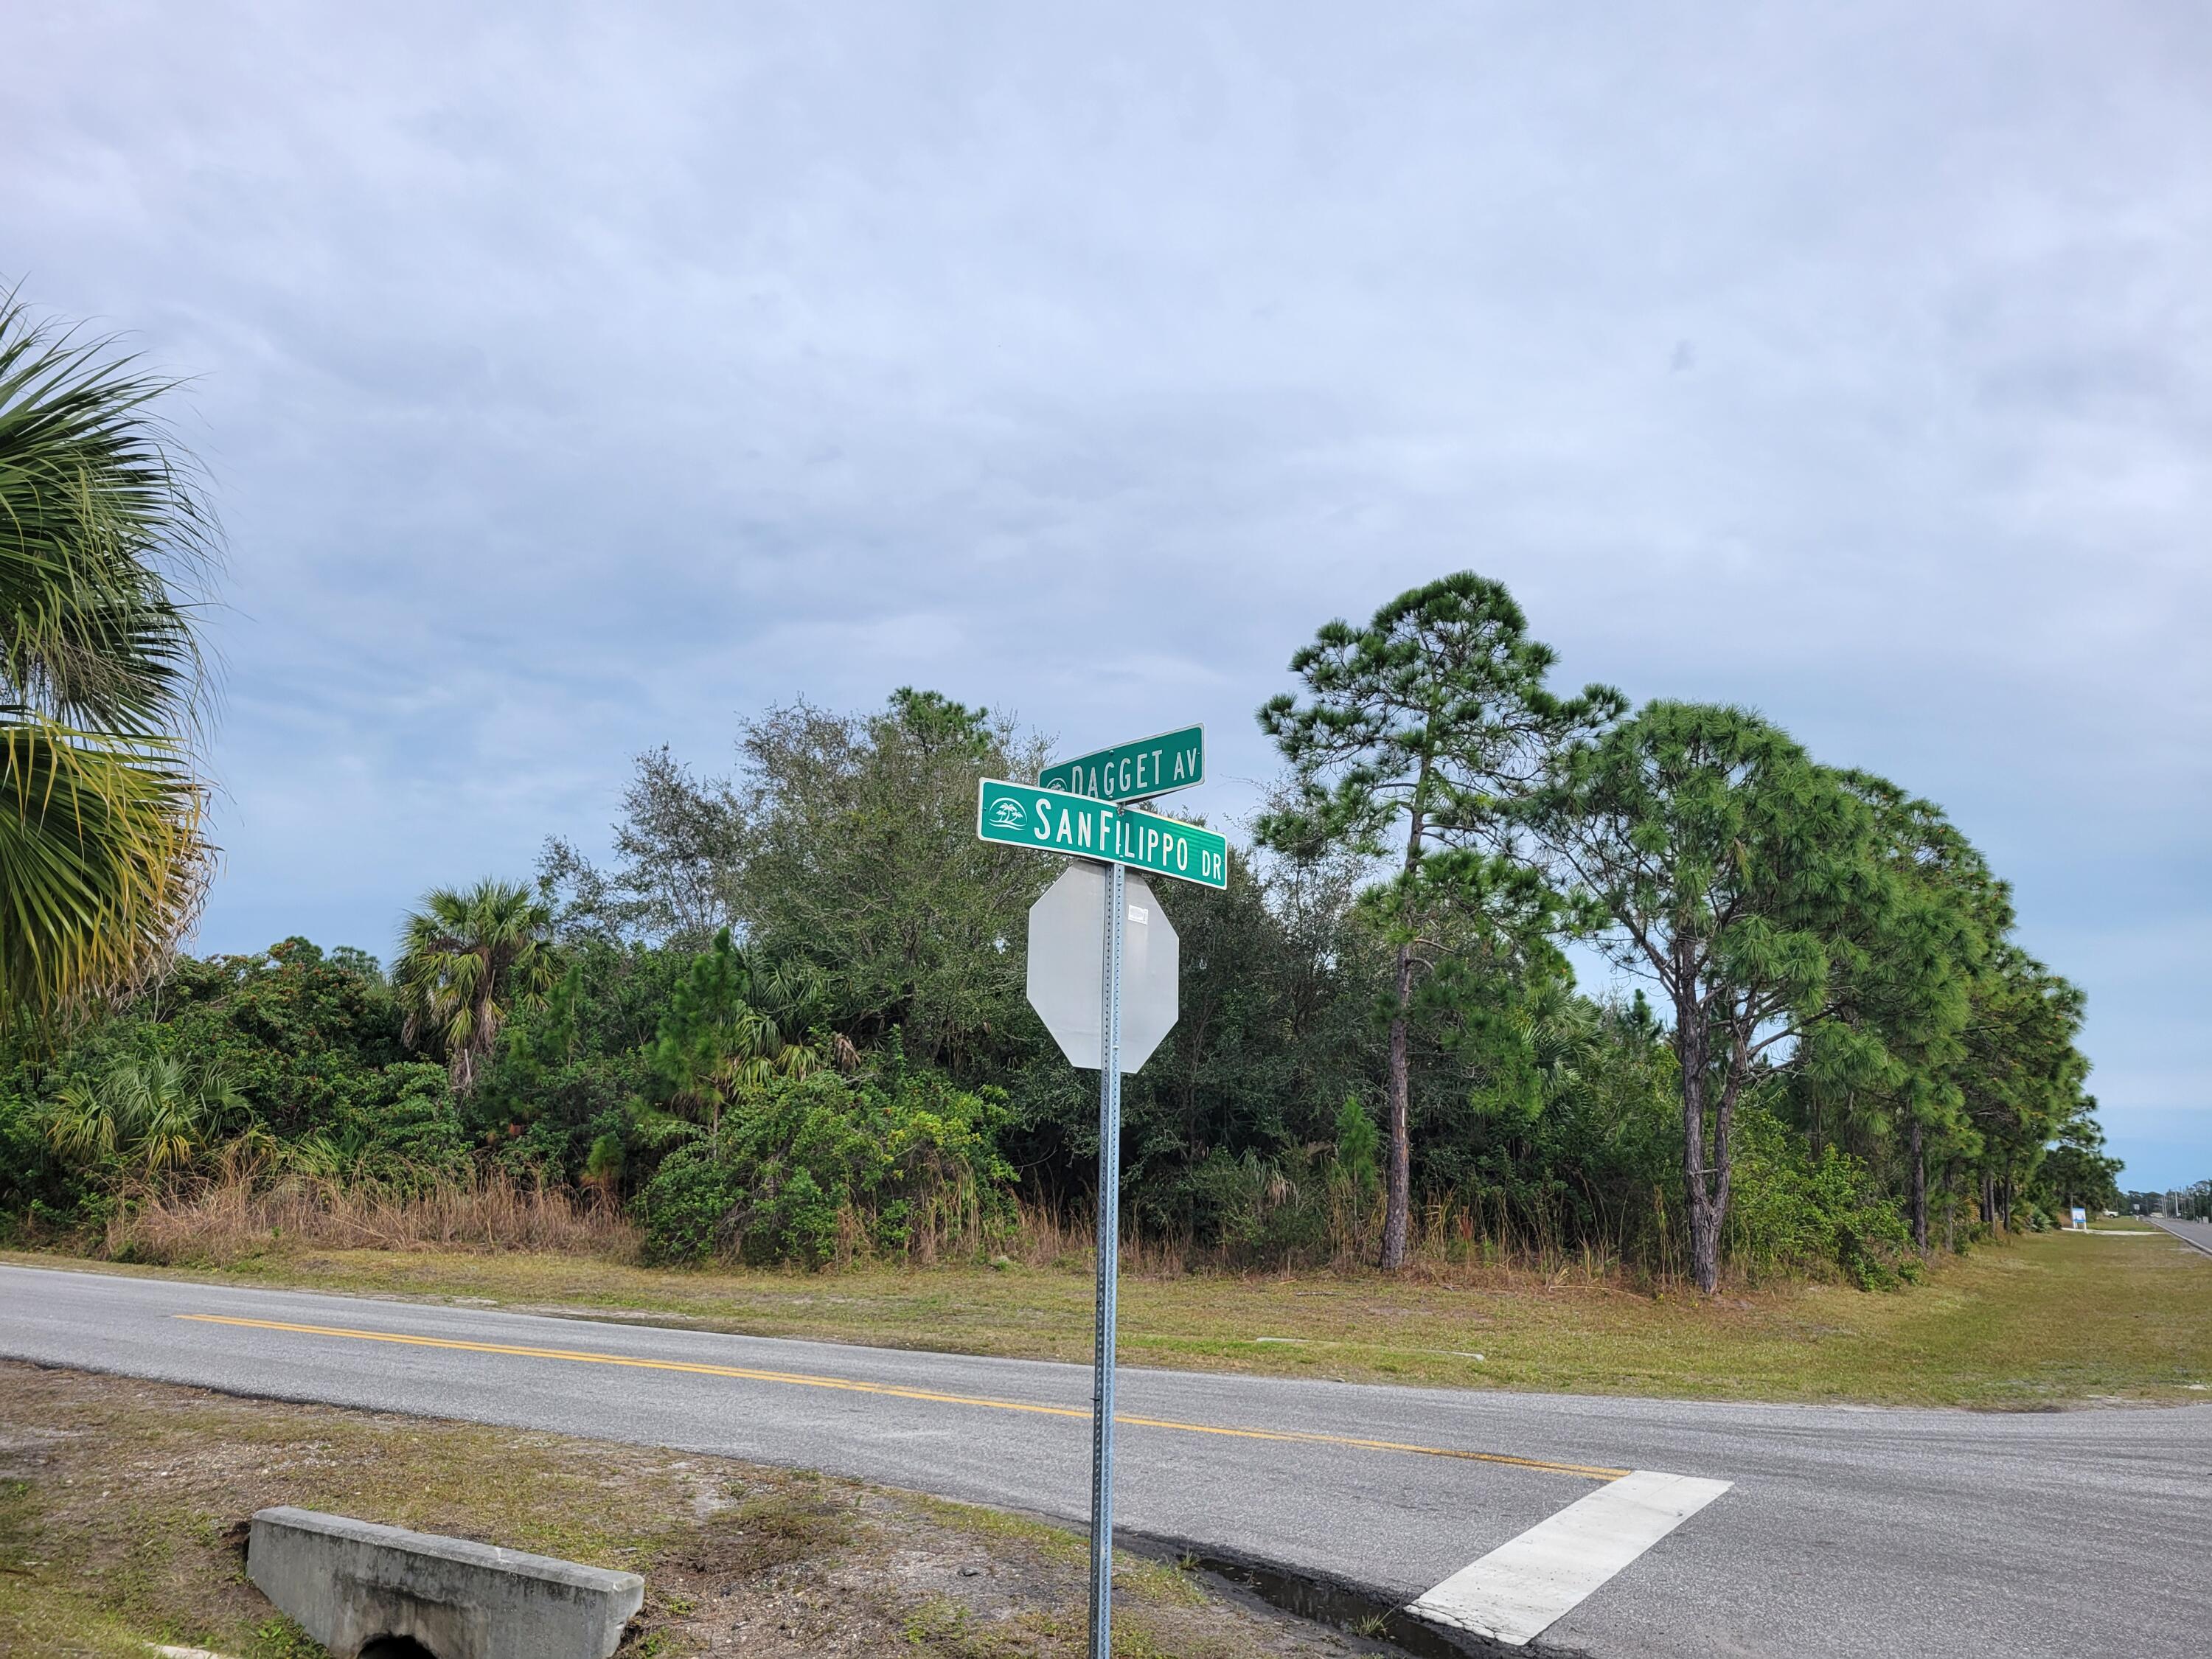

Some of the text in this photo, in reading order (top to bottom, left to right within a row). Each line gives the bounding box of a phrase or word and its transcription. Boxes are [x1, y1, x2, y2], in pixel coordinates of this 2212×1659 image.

[1071, 748, 1197, 799] DAGGET AV
[1202, 849, 1222, 880] DR
